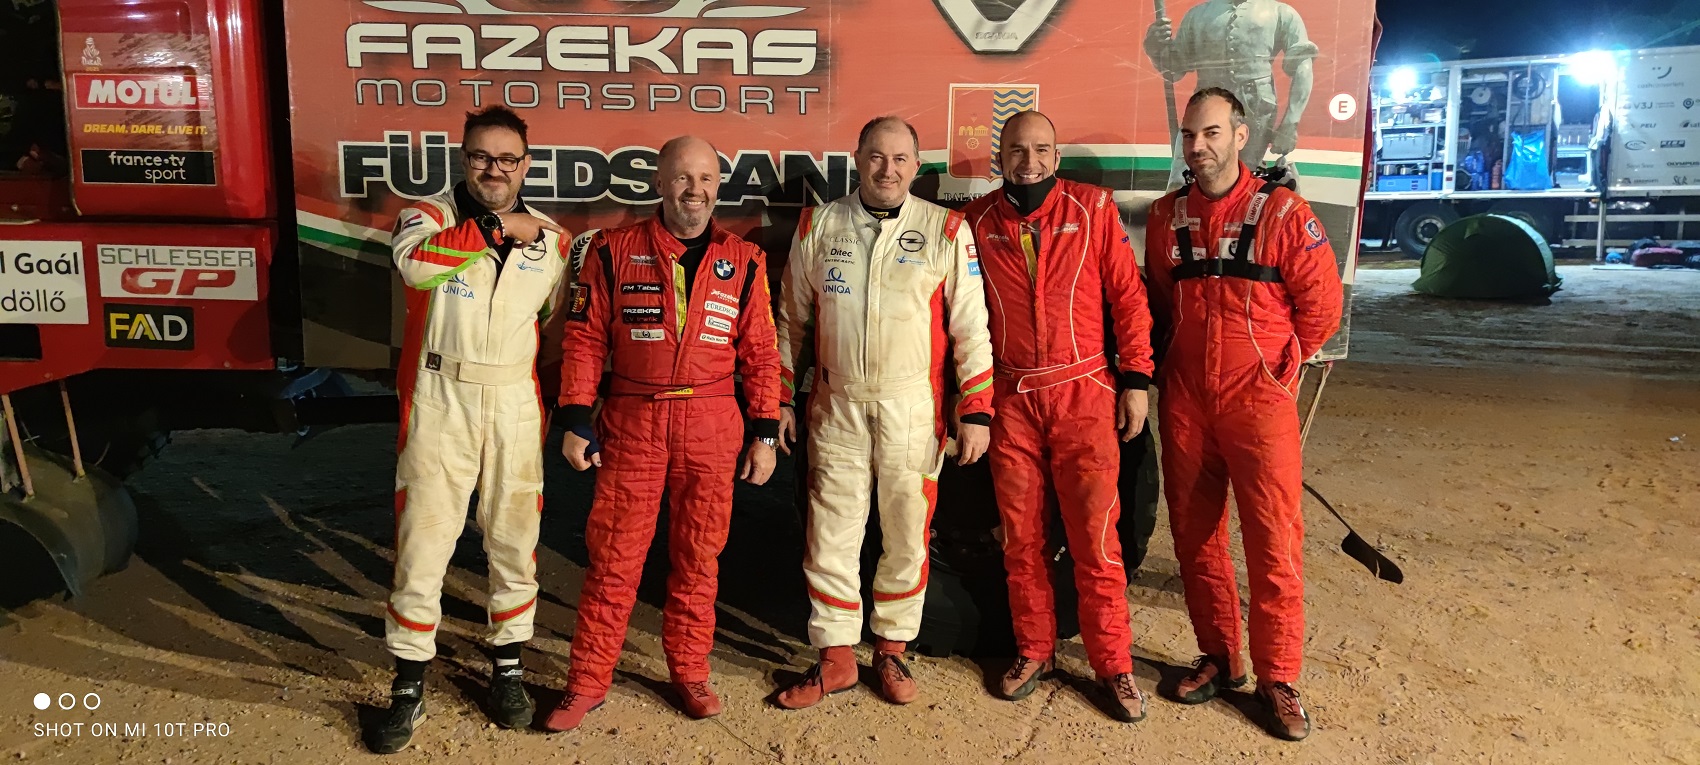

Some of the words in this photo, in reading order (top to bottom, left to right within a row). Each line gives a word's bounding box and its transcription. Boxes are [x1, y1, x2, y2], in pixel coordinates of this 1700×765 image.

[345, 22, 818, 76] FAZEKAS
[87, 79, 197, 106] MOTUL
[355, 79, 821, 115] MOTORSPORT
[1338, 101, 1348, 114] E
[83, 123, 129, 134] DREAM.
[130, 124, 166, 135] DARE.
[167, 125, 194, 135] LIVE
[195, 126, 209, 135] IT.
[144, 168, 187, 184] sport
[1249, 196, 1263, 221] SIMPSON
[14, 251, 79, 275] Gaál
[100, 247, 254, 268] SCHLESSER
[830, 248, 853, 258] Ditec
[121, 267, 236, 296] GP
[442, 284, 475, 300] UNIQA
[636, 284, 661, 292] Tabak
[822, 284, 851, 295] UNIQA
[1, 288, 66, 312] döllő
